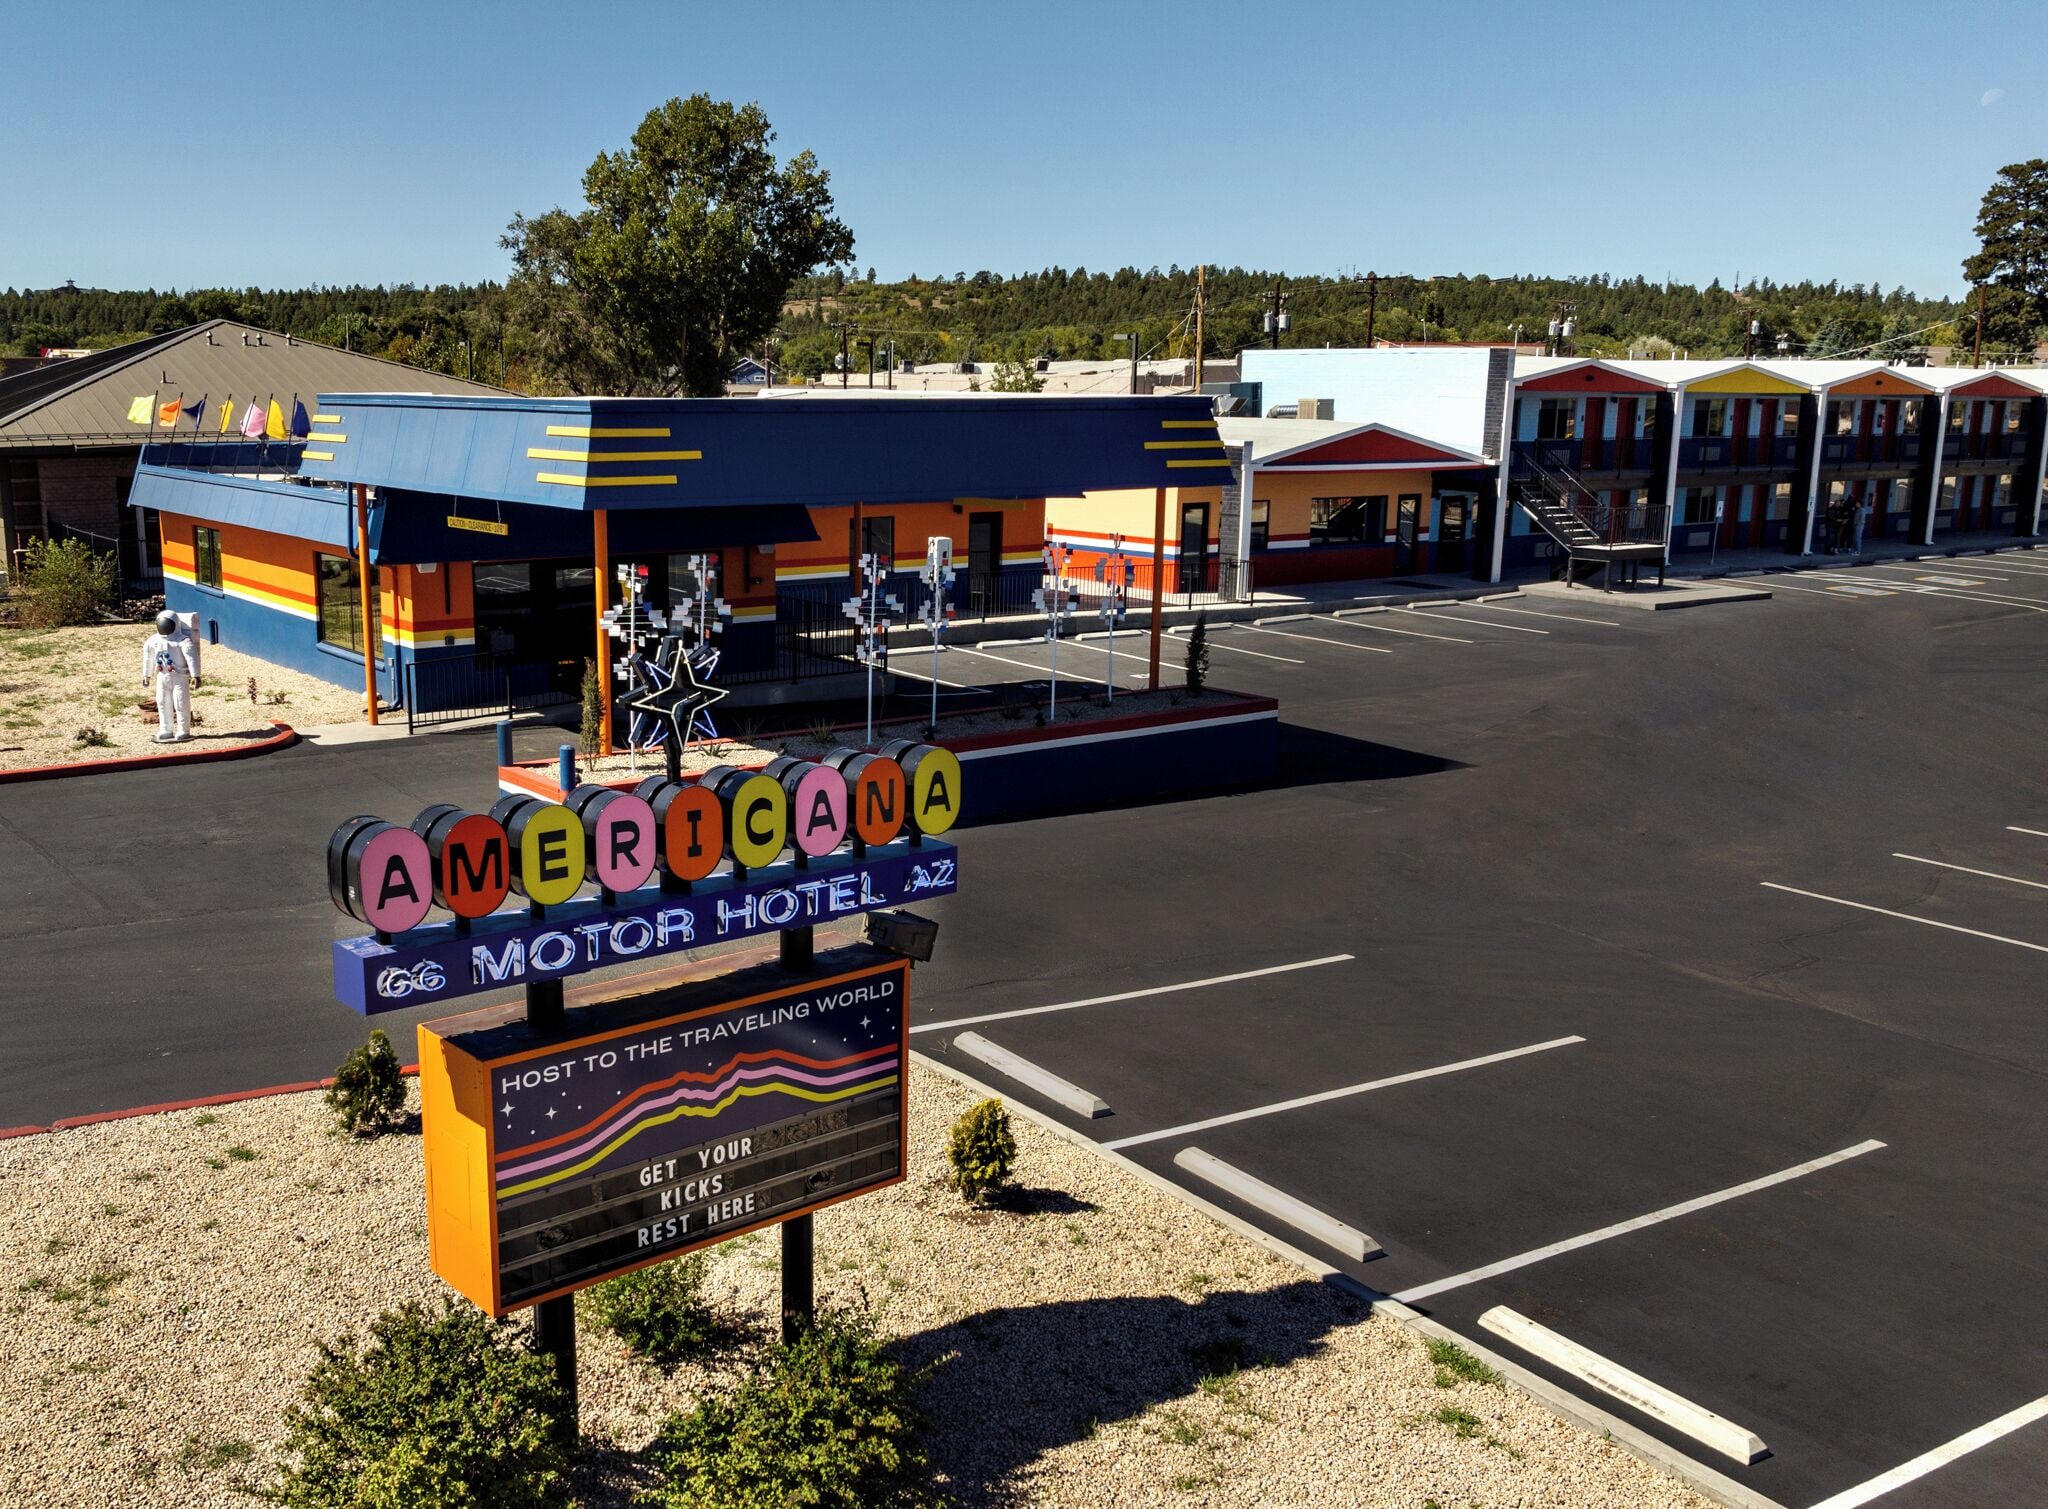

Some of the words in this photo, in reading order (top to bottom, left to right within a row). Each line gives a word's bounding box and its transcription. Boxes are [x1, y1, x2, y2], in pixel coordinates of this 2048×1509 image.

[377, 770, 951, 911] AMERICANA
[472, 907, 695, 985] MOTOR
[717, 871, 887, 936] HOTEL
[904, 858, 955, 893] AZ
[502, 1061, 577, 1095] HOST
[584, 1050, 617, 1074] TO
[624, 1036, 673, 1062] THE
[679, 1002, 810, 1048] TRAVELING
[816, 980, 895, 1013] WORLD
[640, 1159, 677, 1187] GET
[698, 1137, 752, 1169] YOUR
[661, 1174, 723, 1211] KICKS
[638, 1214, 690, 1248] REST
[708, 1193, 755, 1225] HERE
